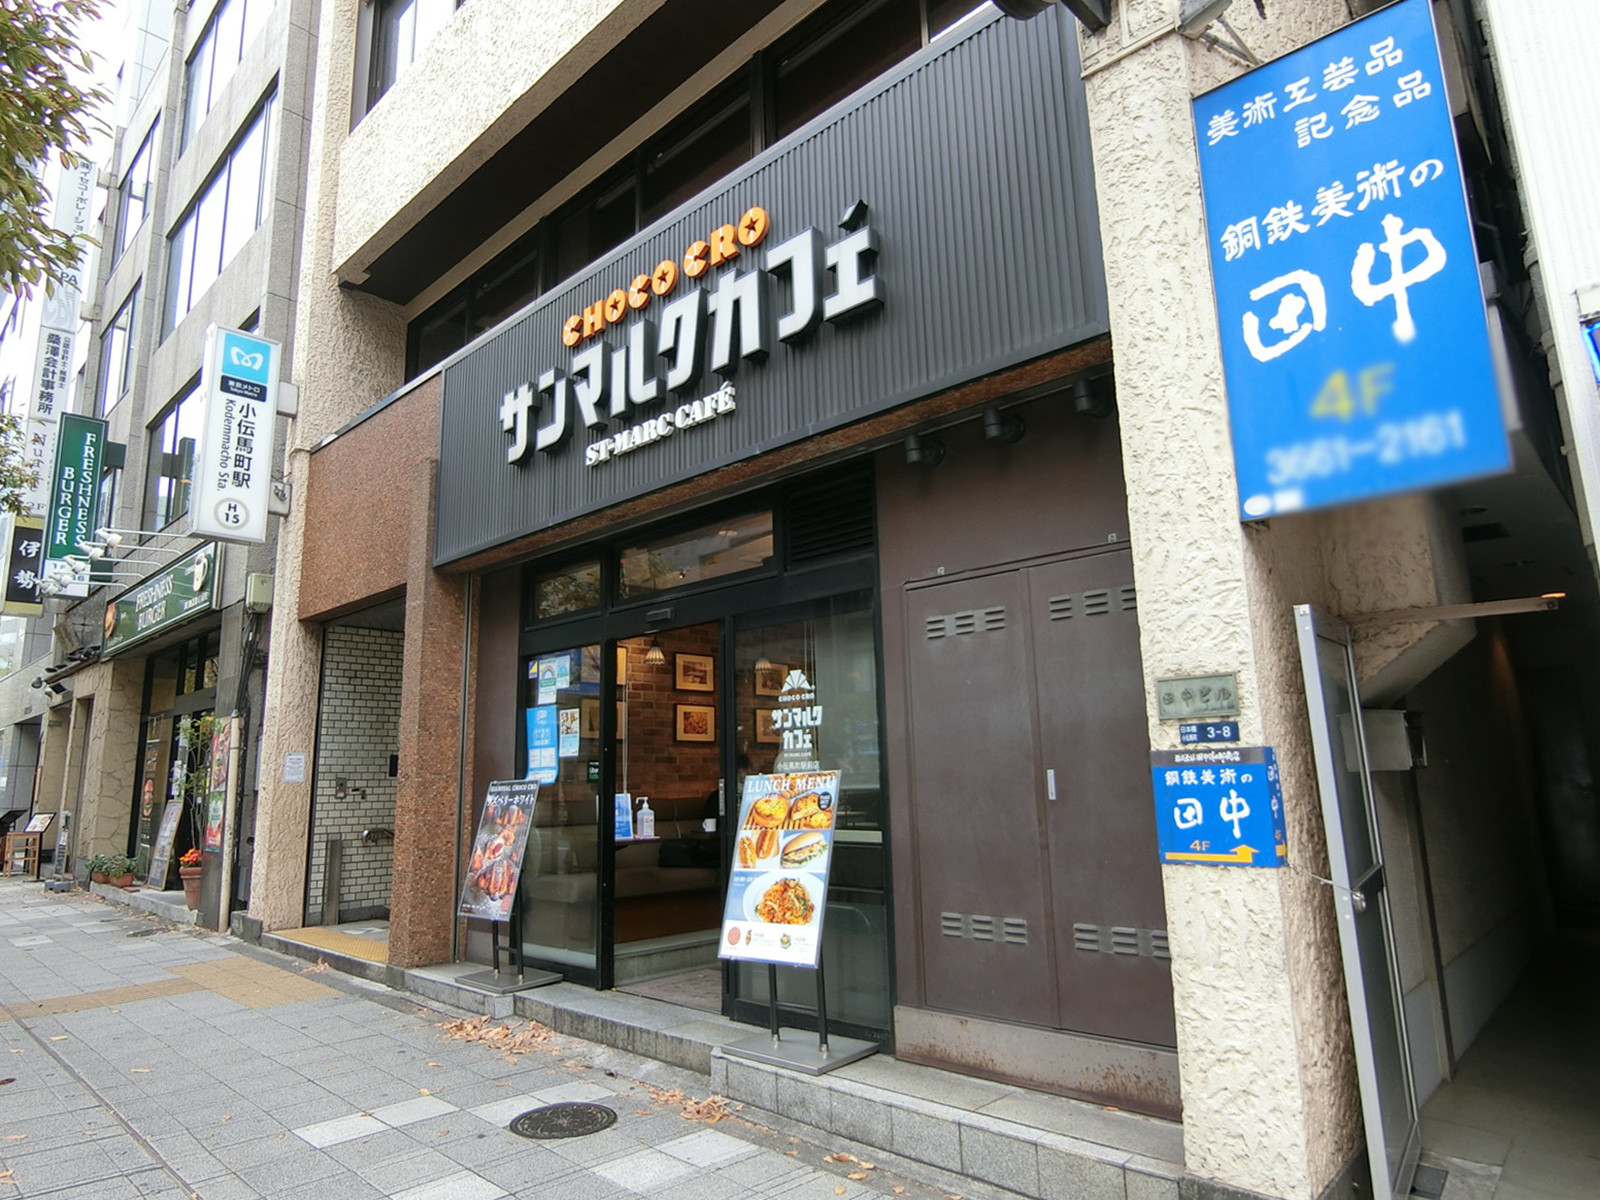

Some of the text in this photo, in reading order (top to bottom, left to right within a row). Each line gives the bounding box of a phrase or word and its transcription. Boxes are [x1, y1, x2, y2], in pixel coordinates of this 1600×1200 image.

[1207, 36, 1404, 146] 美術工芸品
[1294, 70, 1432, 148] 記念品
[1220, 158, 1444, 261] 銅鉄美術の
[562, 206, 770, 347] CHOCO CRO
[1242, 213, 1447, 363] 田中
[500, 199, 885, 465] サンマルクカフェ
[1308, 362, 1395, 423] 4F
[219, 398, 236, 469] Kodemmacho
[232, 402, 257, 489] 小伝馬町駅
[55, 466, 75, 546] BURGER
[74, 432, 97, 547] FRESHNESS
[225, 513, 240, 524] 15
[228, 503, 237, 513] H
[1206, 726, 1231, 738] 3-8
[747, 775, 836, 793] LUNCH MENU
[1173, 789, 1250, 839] 田中
[1190, 839, 1210, 851] 4F
